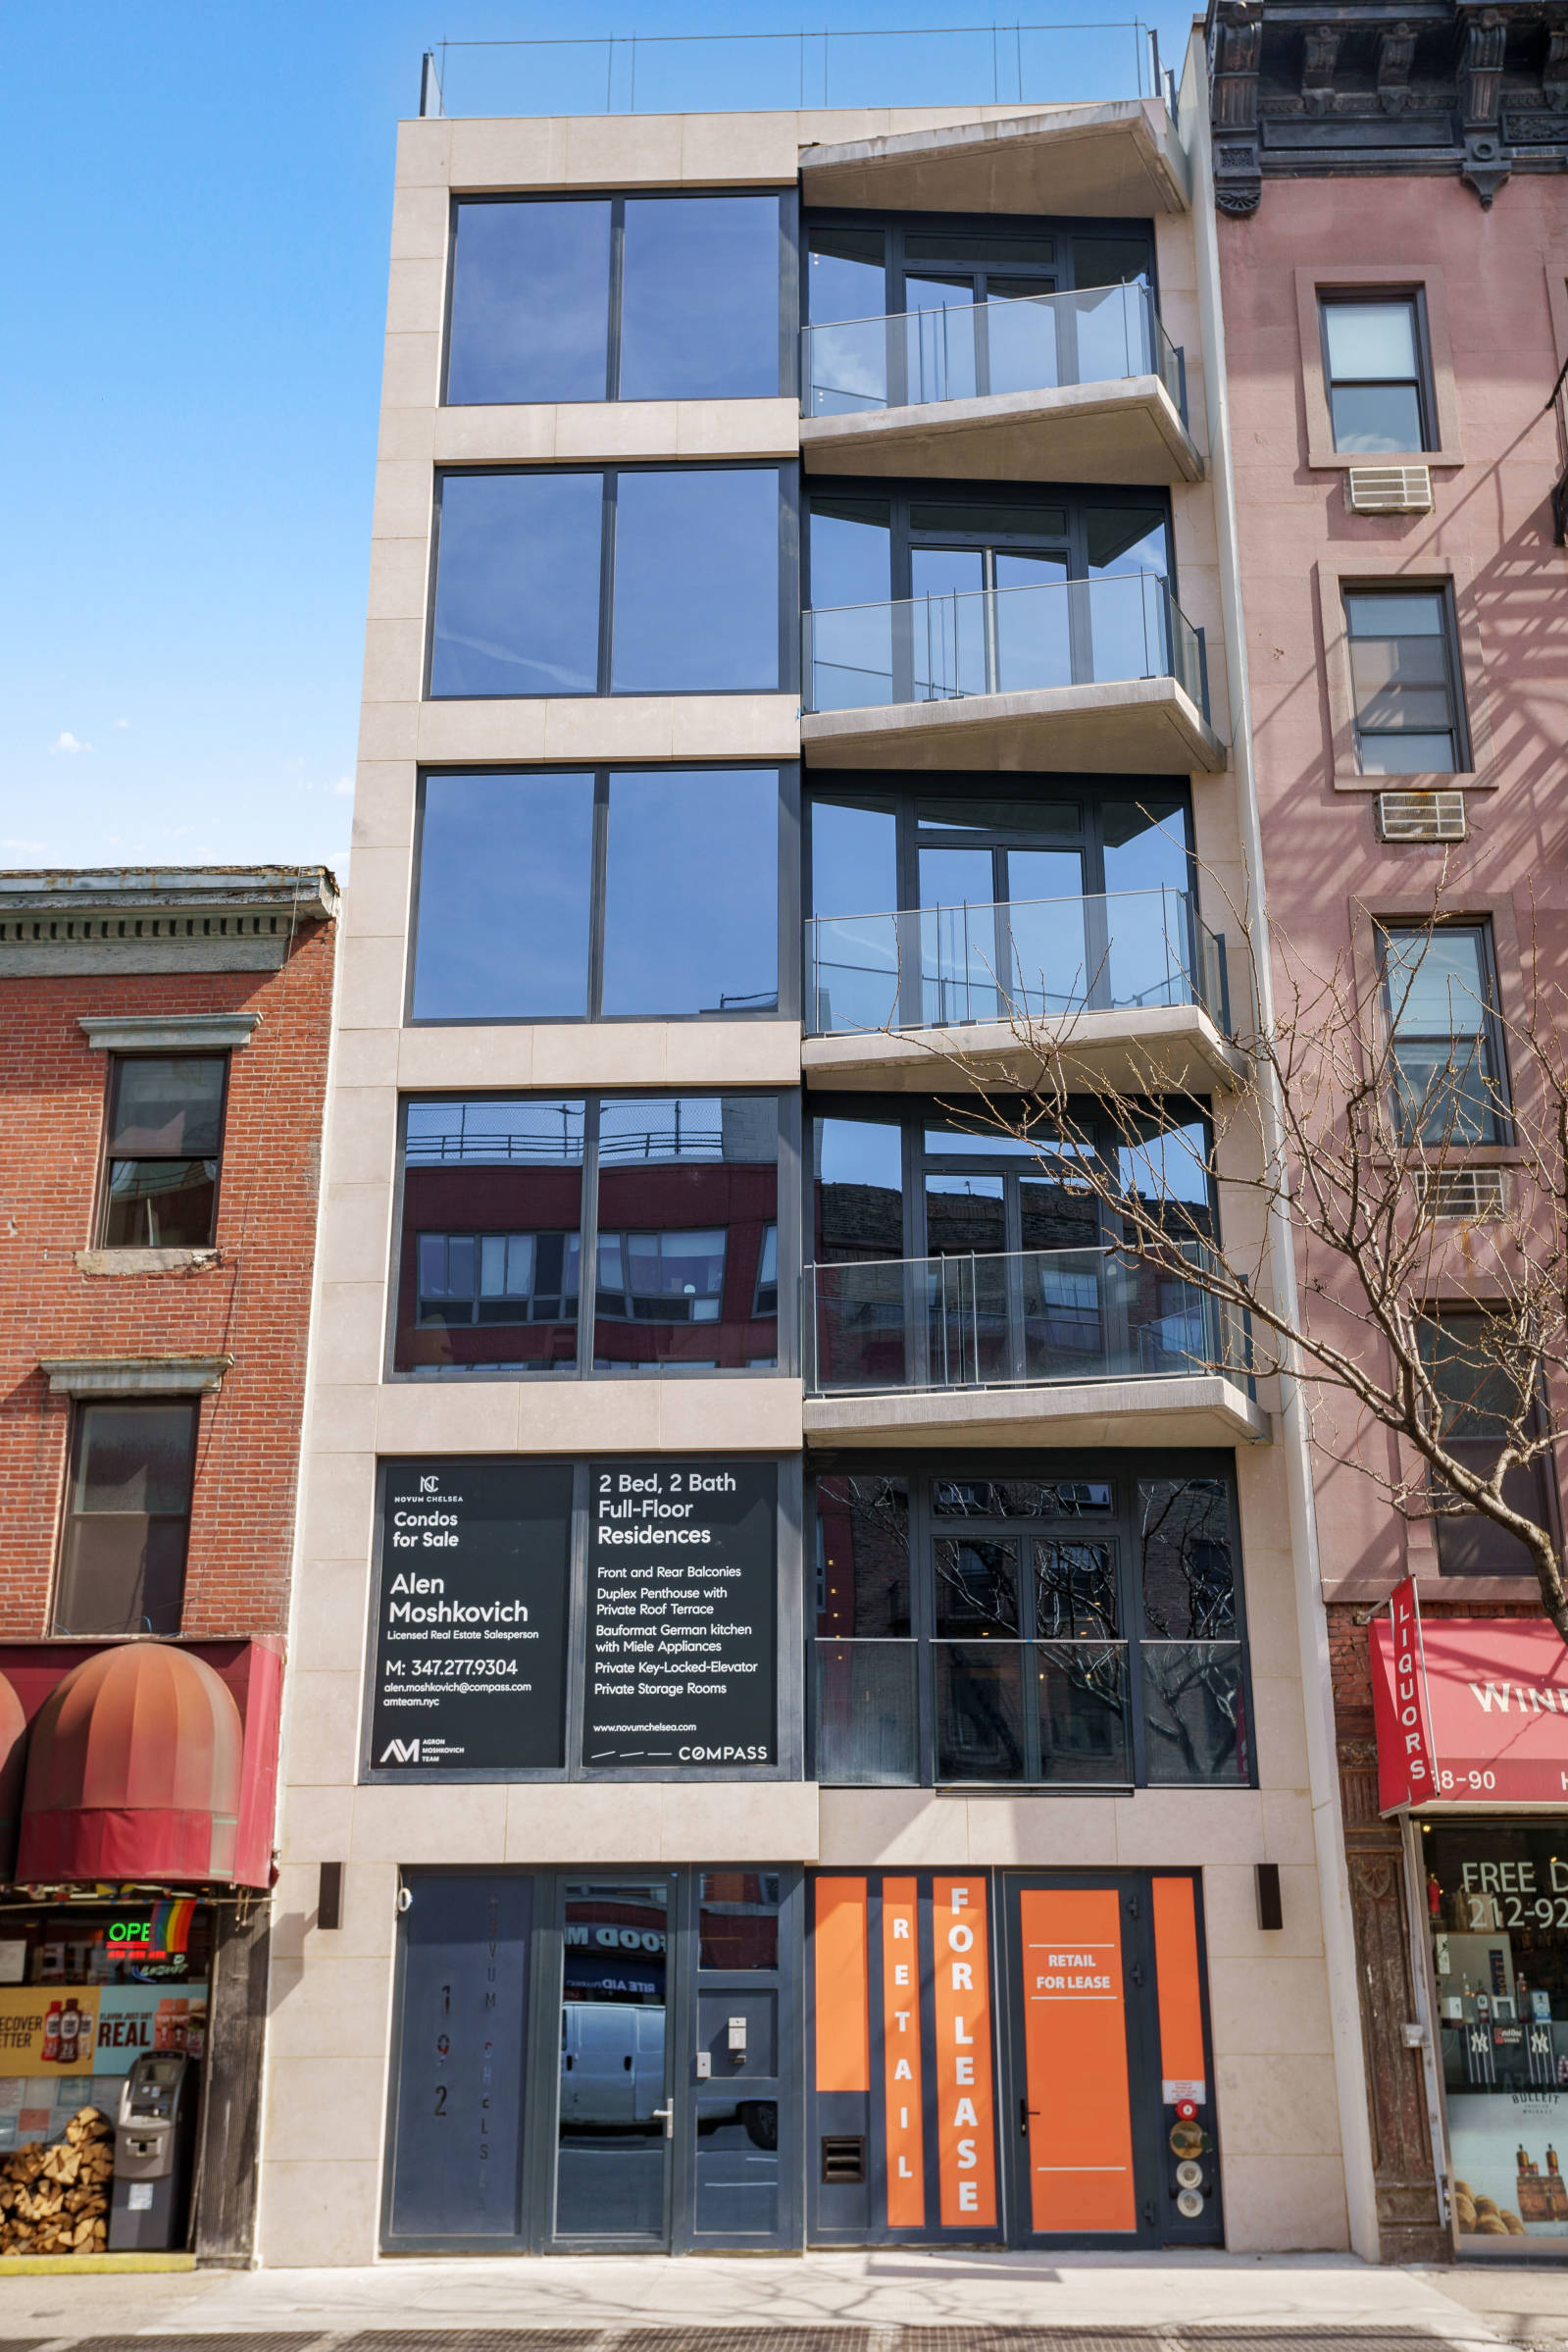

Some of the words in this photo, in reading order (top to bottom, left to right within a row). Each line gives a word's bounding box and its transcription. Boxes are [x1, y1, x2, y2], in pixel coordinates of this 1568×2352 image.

[599, 1474, 612, 1493] 2
[619, 1472, 663, 1495] Bed,
[670, 1473, 683, 1492] 2
[688, 1472, 736, 1492] Bath
[598, 1498, 694, 1519] Full-Floor
[393, 1509, 458, 1527] Condos
[392, 1531, 419, 1548] for
[422, 1530, 460, 1548] Sale
[598, 1524, 711, 1545] Residences
[597, 1566, 628, 1578] Front
[630, 1565, 654, 1578] and
[656, 1565, 684, 1578] Rear
[687, 1565, 742, 1578] Balconies
[389, 1571, 444, 1595] Alen
[597, 1587, 637, 1602] Duplex
[640, 1586, 701, 1600] Penthouse
[703, 1586, 728, 1599] with
[389, 1600, 529, 1623] Moshkovich
[596, 1604, 636, 1615] Private
[639, 1603, 668, 1615] Roof
[670, 1603, 715, 1615] Terrace
[387, 1629, 429, 1640] Licensed
[430, 1629, 451, 1640] Real
[453, 1629, 482, 1640] Estate
[483, 1629, 539, 1641] Salesperson
[595, 1623, 658, 1637] Bauformat
[660, 1623, 707, 1636] German
[710, 1622, 752, 1635] kitchen
[595, 1640, 620, 1653] with
[623, 1640, 655, 1653] Miele
[657, 1639, 723, 1655] Appliances
[385, 1660, 406, 1676] M:
[411, 1659, 519, 1676] 347.277.9304
[594, 1662, 635, 1674] Private
[638, 1660, 759, 1676] Key-Locked-Elevator
[383, 1681, 532, 1694] alen.moshkovich@compass.com
[594, 1682, 635, 1695] Private
[637, 1682, 684, 1698] Storage
[686, 1682, 728, 1695] Rooms
[1398, 1604, 1426, 1780] LIQUORS
[382, 1697, 440, 1709] amteam.nyc
[592, 1721, 697, 1732] www.novumchelsea.com
[678, 1746, 768, 1761] COMPASS
[1462, 1862, 1537, 1893] FREE
[1467, 1896, 1568, 1929] 212-92
[109, 1922, 151, 1942] OPE
[947, 1887, 974, 1991] FOR
[1048, 1954, 1096, 1968] RETAIL
[1037, 1975, 1066, 1989] FOR
[1067, 1975, 1111, 1989] LEASE
[0, 2031, 32, 2049] TTER
[97, 2020, 151, 2048] REAL
[893, 1917, 913, 2178] RETAIL
[1512, 2092, 1560, 2105] BULLEIT
[953, 2016, 979, 2212] LEASE
